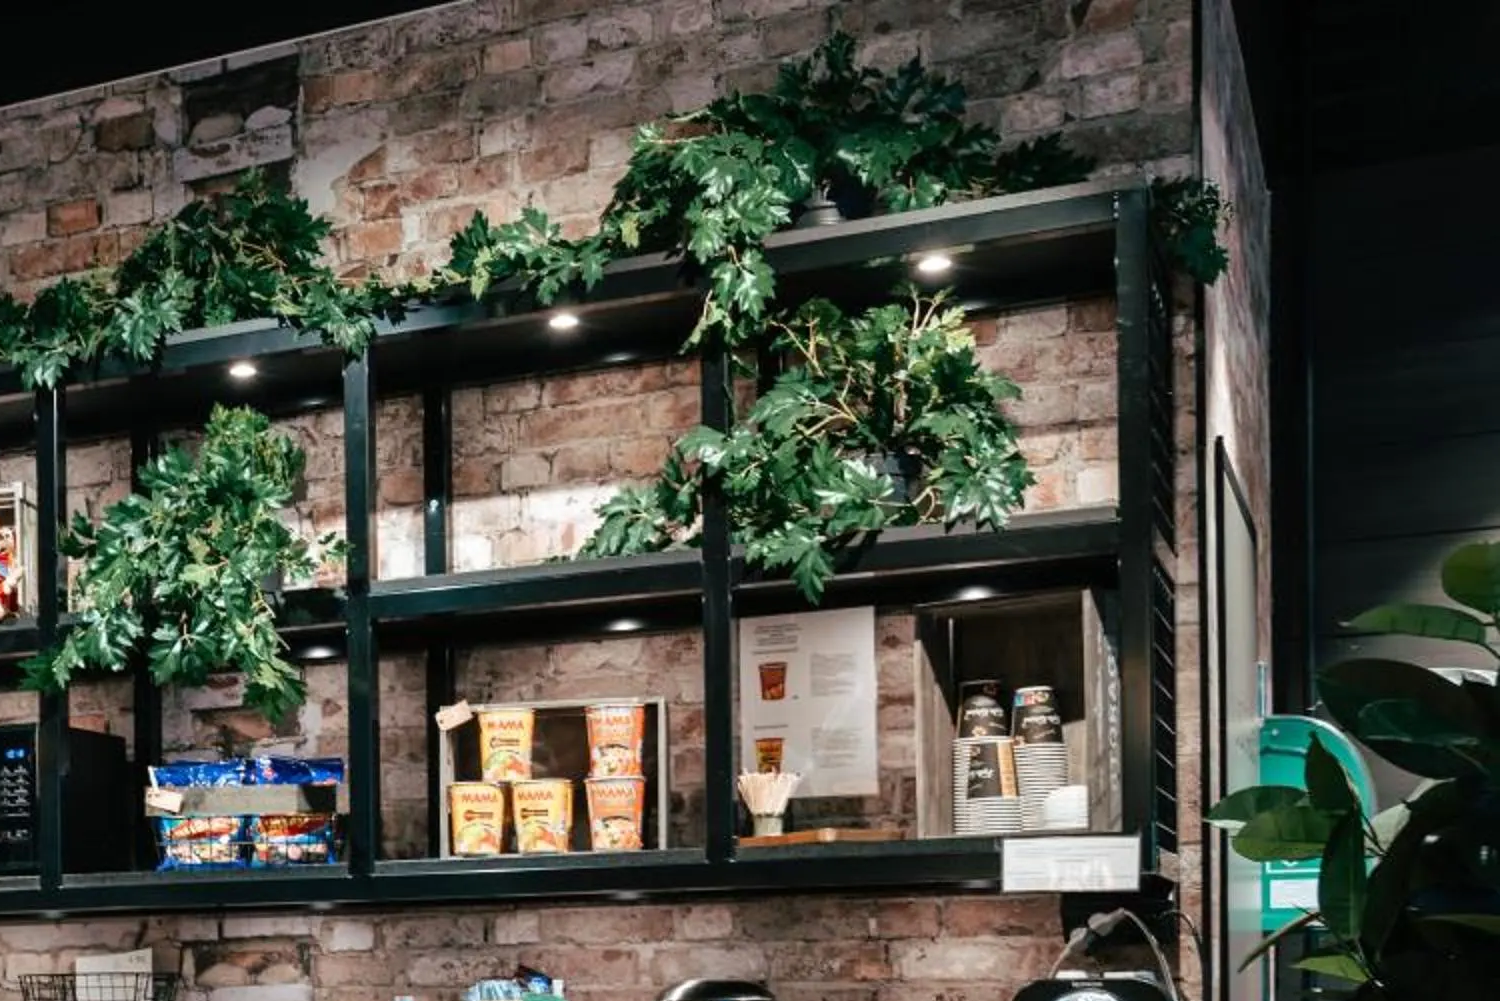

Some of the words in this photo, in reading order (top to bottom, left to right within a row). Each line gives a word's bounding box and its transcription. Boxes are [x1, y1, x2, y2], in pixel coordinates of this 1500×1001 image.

[487, 720, 525, 730] MAMA
[460, 791, 499, 803] MAMA
[516, 790, 554, 802] MAMA
